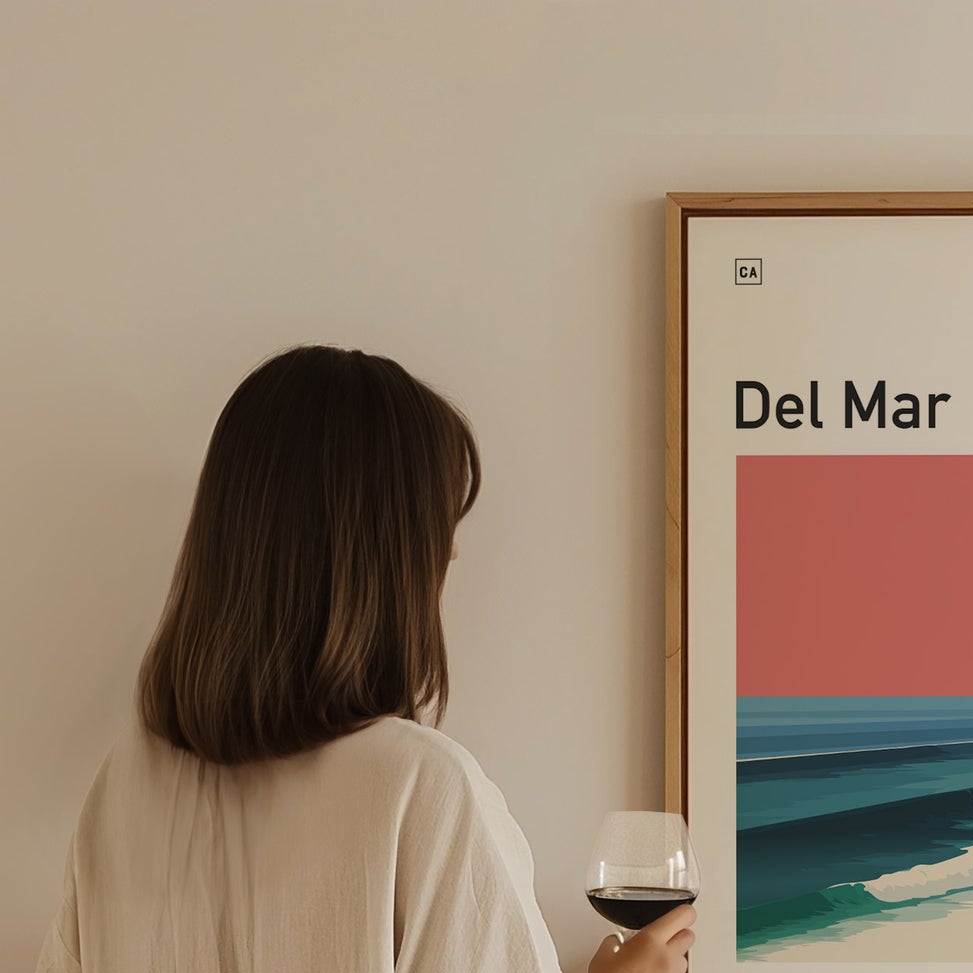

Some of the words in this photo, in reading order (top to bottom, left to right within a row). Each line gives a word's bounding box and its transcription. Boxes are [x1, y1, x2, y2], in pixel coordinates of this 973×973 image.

[739, 266, 758, 279] CA
[735, 380, 824, 430] Del
[844, 380, 952, 430] Mar
